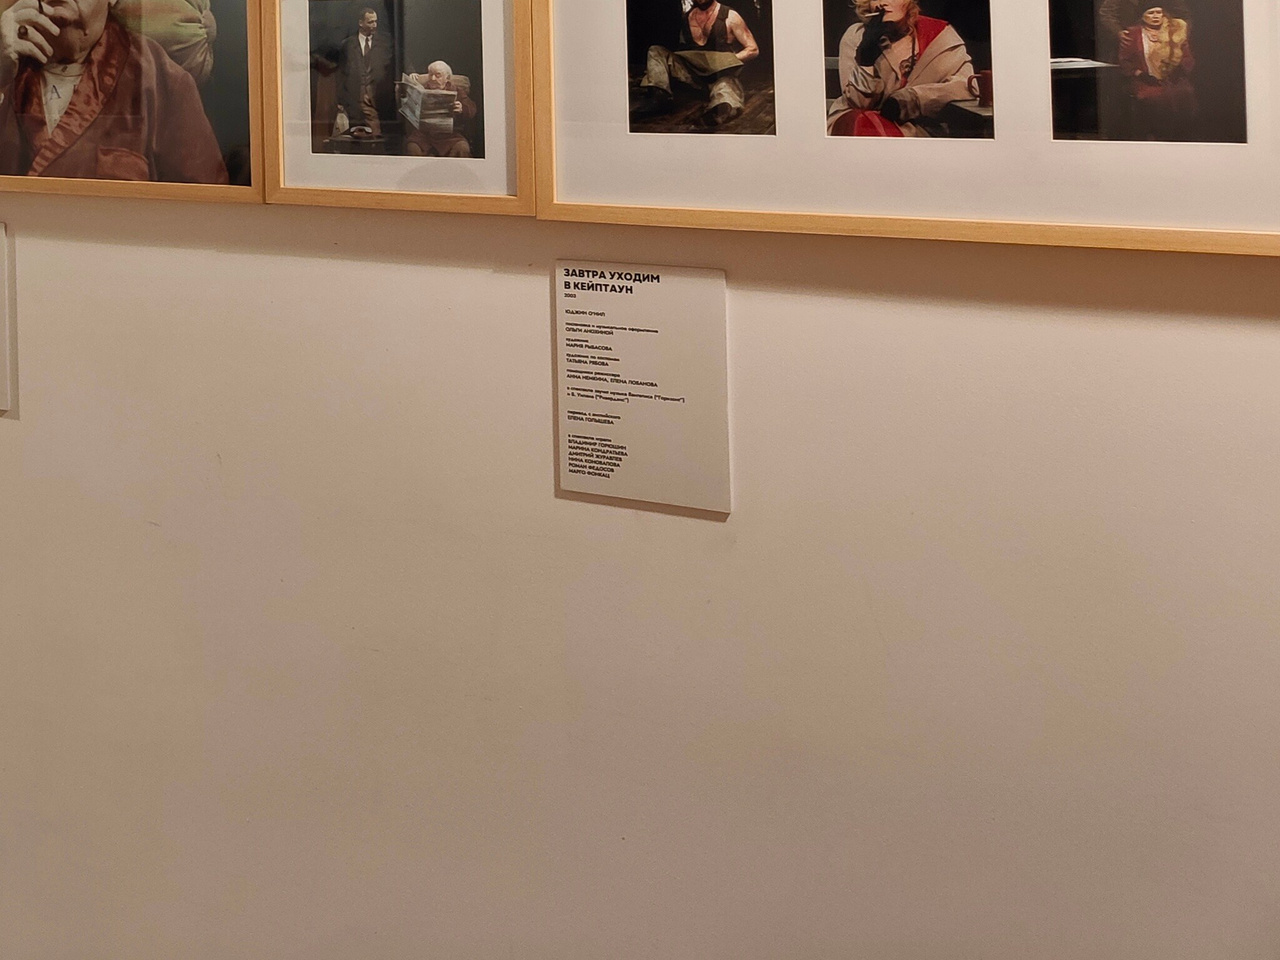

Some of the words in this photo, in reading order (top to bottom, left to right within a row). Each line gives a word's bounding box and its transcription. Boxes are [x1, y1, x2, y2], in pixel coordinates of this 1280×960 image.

[564, 268, 606, 279] ЗАВТРА
[609, 271, 660, 283] УХОДИМ
[564, 281, 571, 289] В
[574, 281, 633, 294] КЕЙПТАУН
